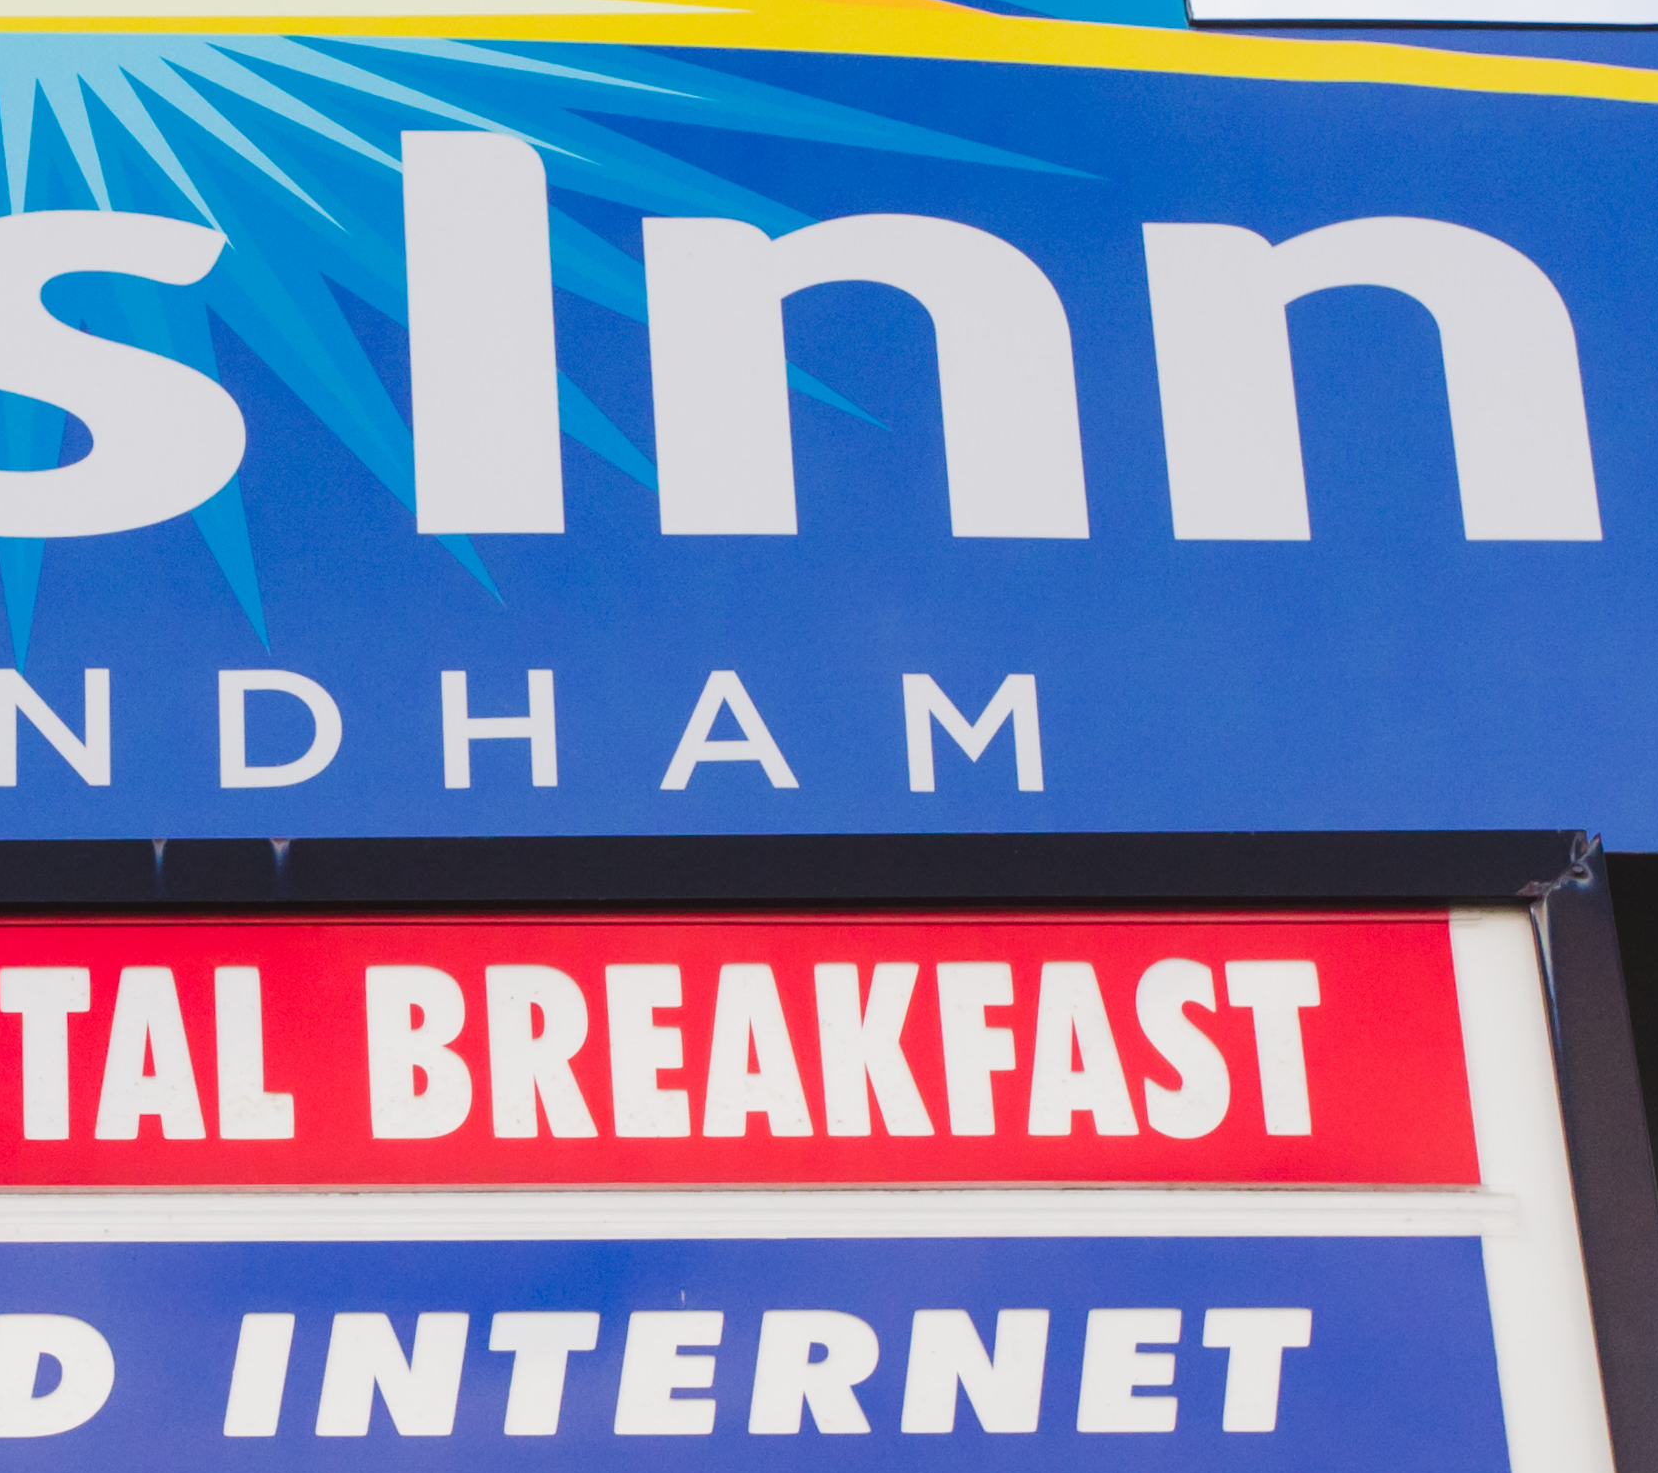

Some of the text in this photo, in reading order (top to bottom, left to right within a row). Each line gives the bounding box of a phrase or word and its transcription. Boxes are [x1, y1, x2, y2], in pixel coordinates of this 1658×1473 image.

[401, 131, 1602, 541] Inn
[365, 958, 1322, 1139] BREAKFAST
[222, 1307, 1314, 1438] INTERNET
